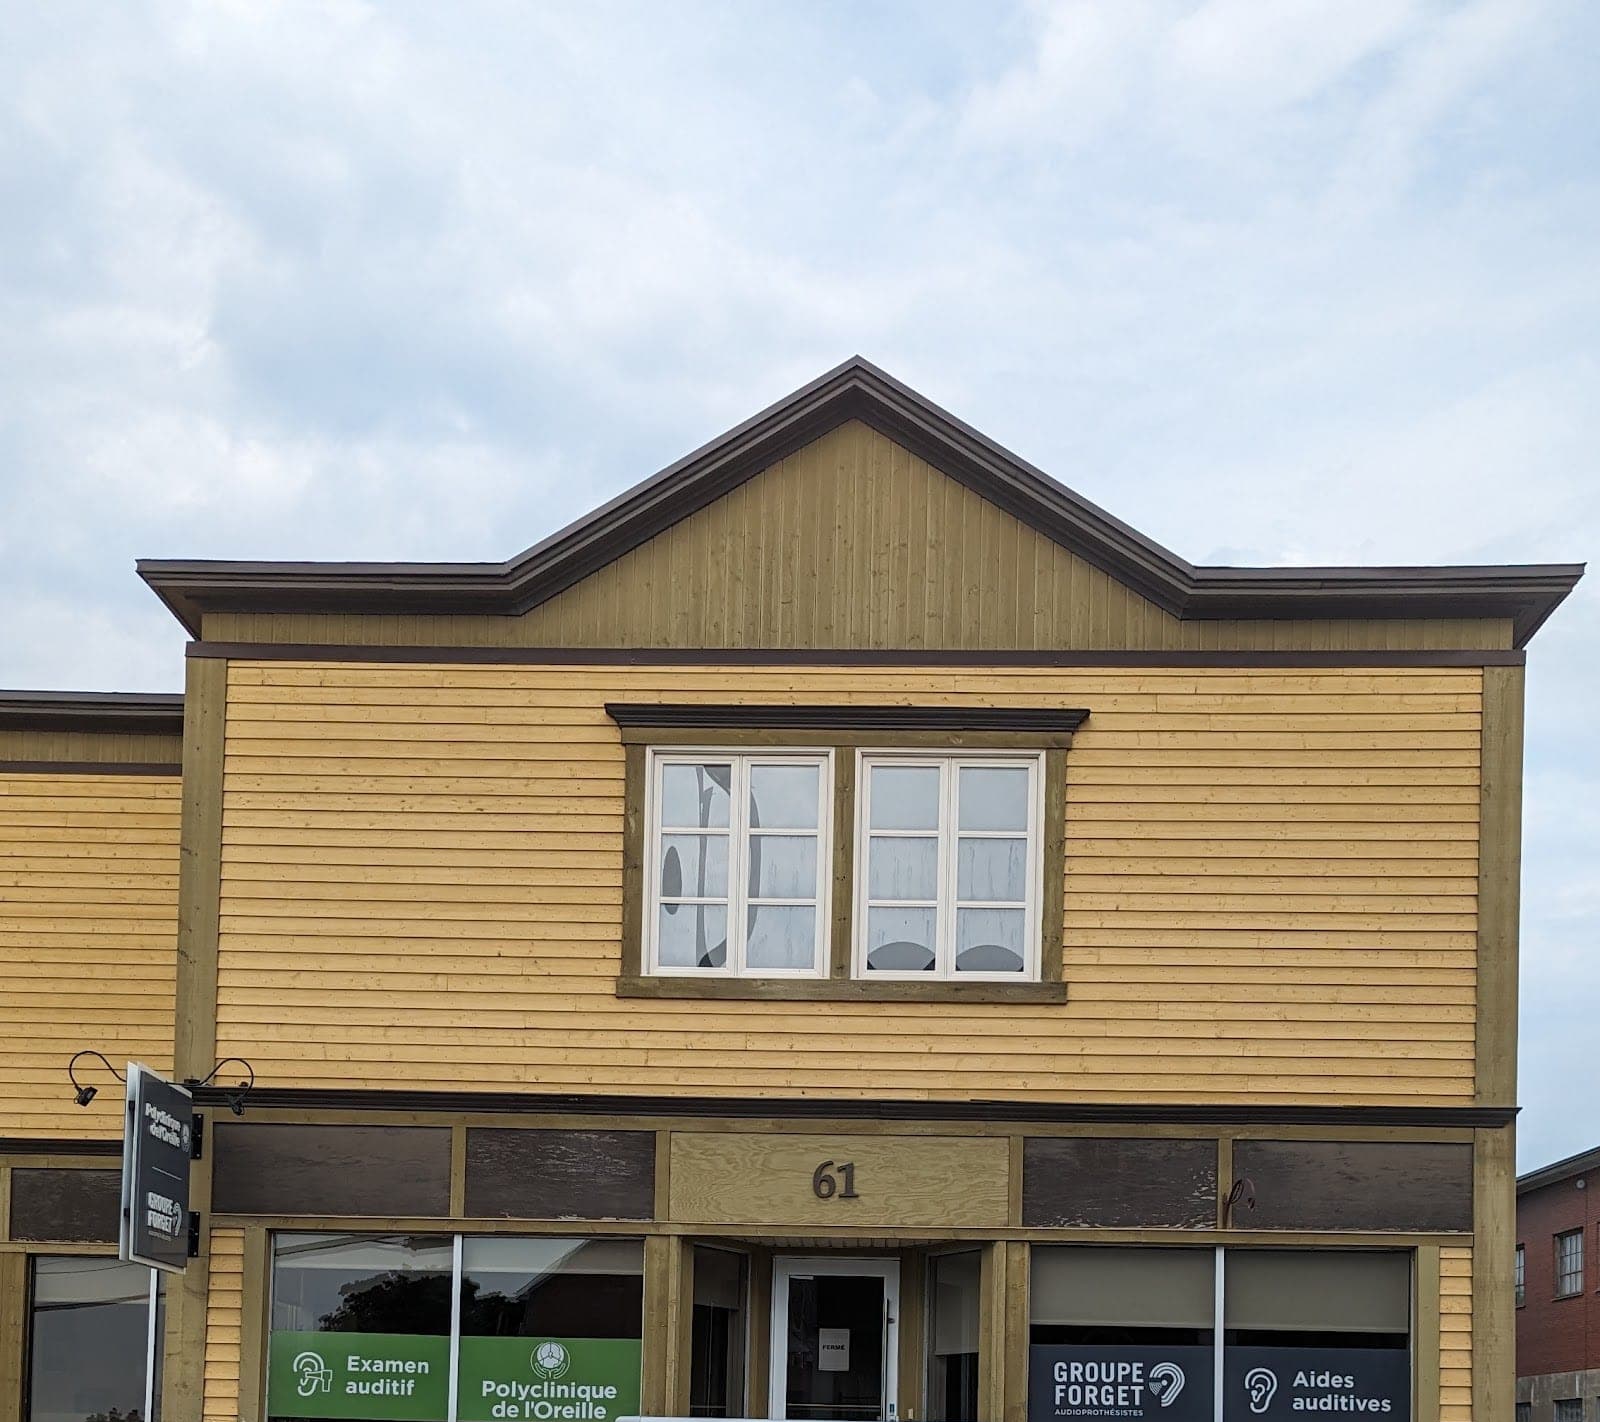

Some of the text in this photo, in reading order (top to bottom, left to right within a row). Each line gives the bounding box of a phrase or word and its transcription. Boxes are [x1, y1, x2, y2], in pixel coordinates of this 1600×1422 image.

[812, 1160, 860, 1199] 61
[147, 1191, 174, 1216] GROUPE
[147, 1210, 173, 1234] FORGET
[347, 1355, 429, 1374] Examen
[1053, 1361, 1145, 1383] GROUPE
[345, 1378, 415, 1397] auditif
[1292, 1370, 1354, 1388] Aides
[481, 1380, 618, 1402] Polyclinique
[1054, 1384, 1145, 1406] FORGET
[491, 1400, 607, 1420] de l'Oreille
[1054, 1408, 1145, 1417] AUDIOPROTHÉSISTES
[1292, 1394, 1392, 1413] auditives
